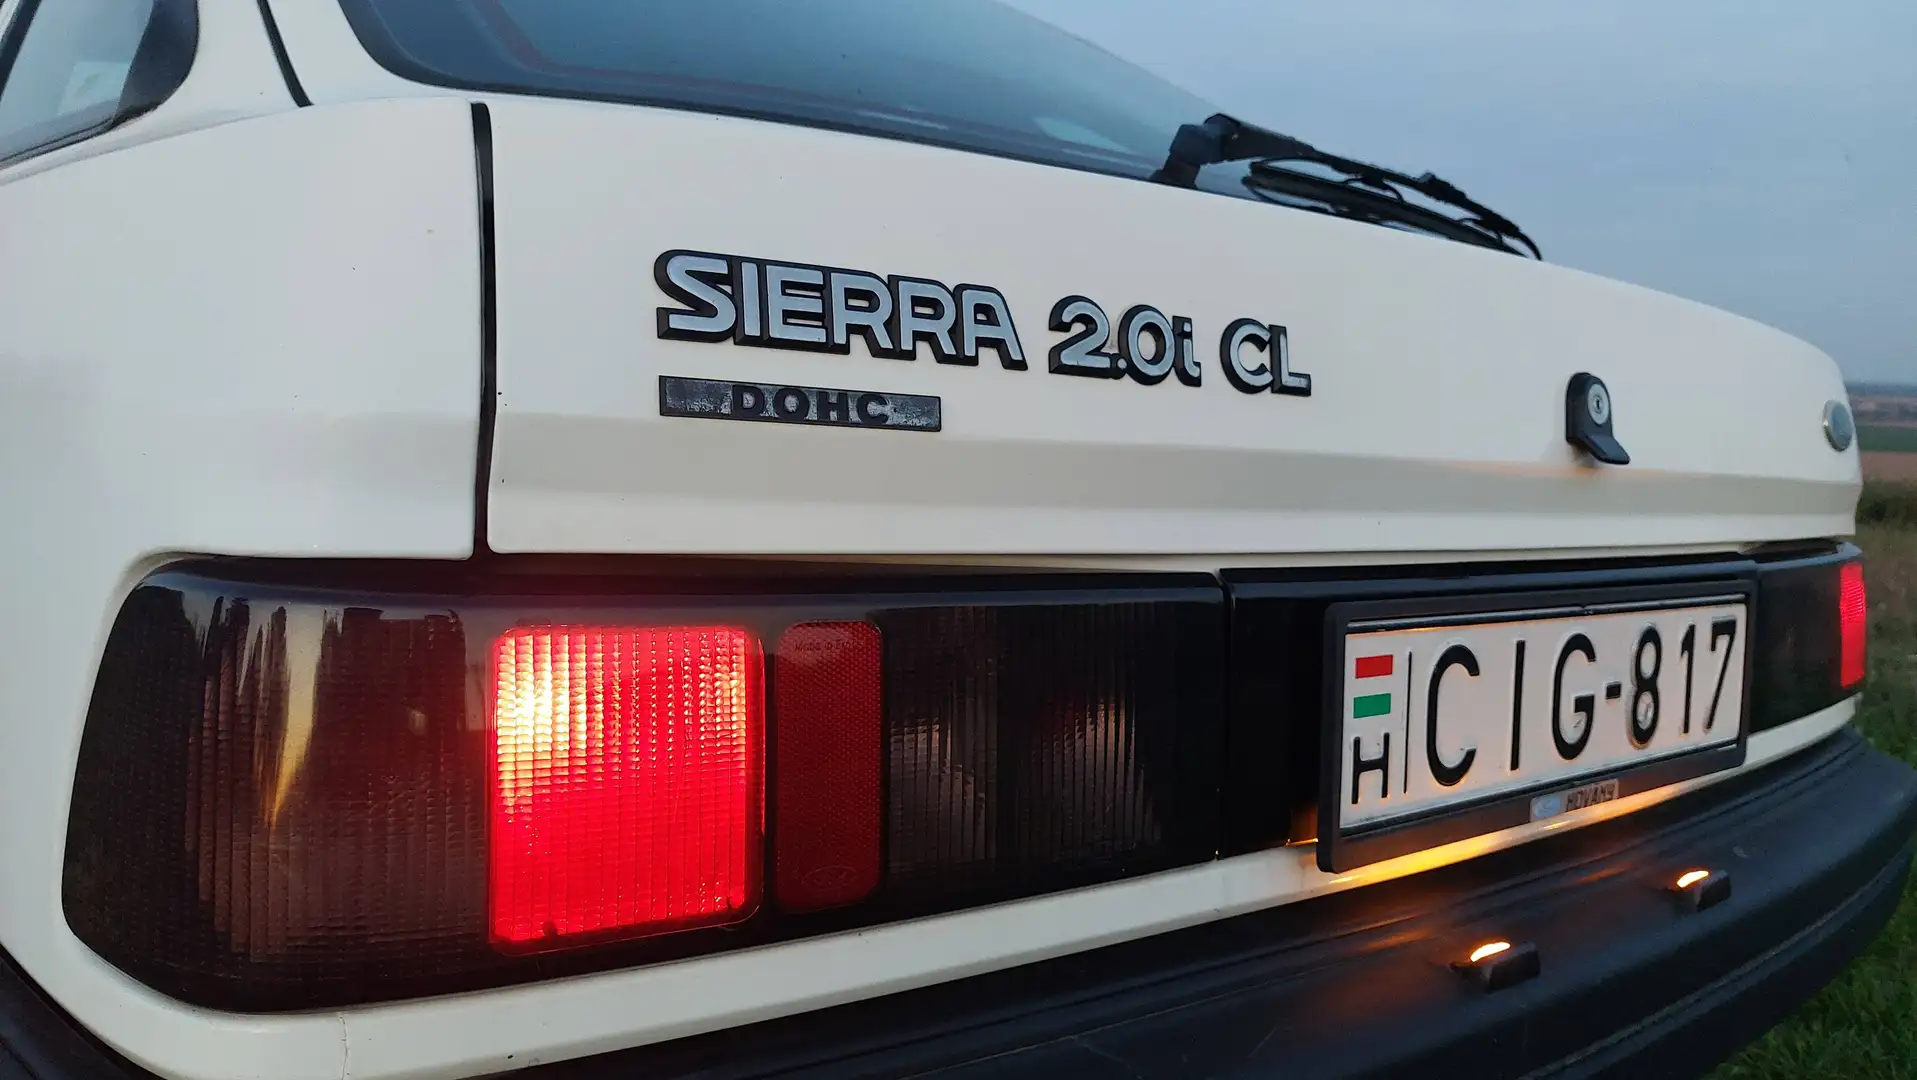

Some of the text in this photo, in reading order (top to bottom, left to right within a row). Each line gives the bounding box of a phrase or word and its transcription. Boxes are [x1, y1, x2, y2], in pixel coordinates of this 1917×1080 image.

[653, 249, 1311, 397] SIERRA 2.0i CL
[732, 384, 892, 426] DOHC
[1351, 617, 1738, 805] H CIG-817
